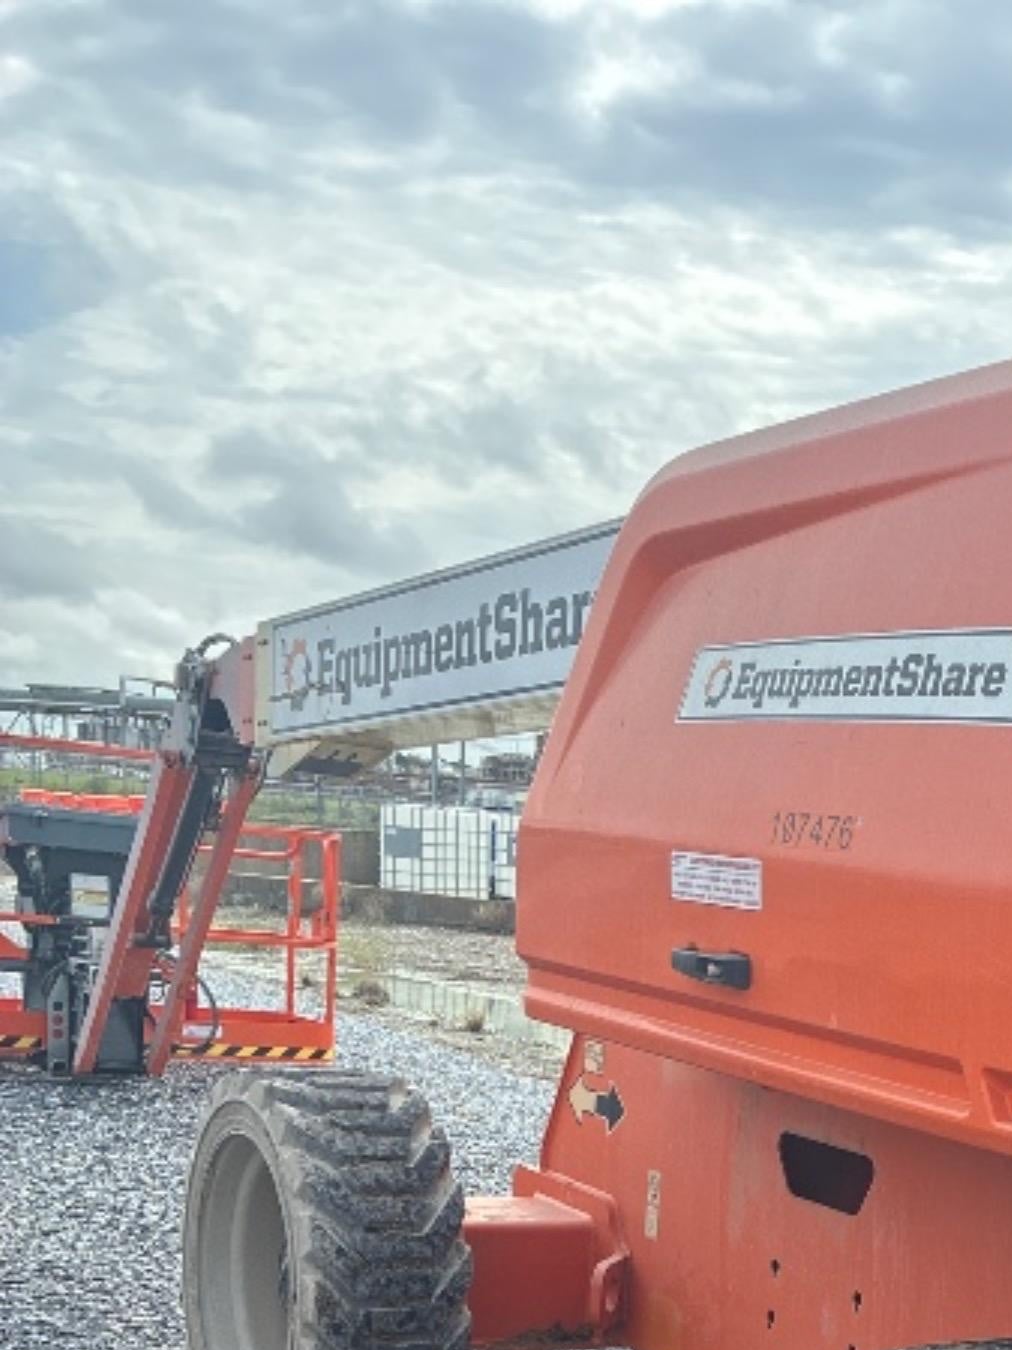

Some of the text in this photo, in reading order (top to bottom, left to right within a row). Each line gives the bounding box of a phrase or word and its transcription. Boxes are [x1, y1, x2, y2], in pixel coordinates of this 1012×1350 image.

[317, 587, 598, 705] EquipmentShar
[731, 653, 1007, 708] EquipmentShare
[769, 811, 855, 850] 107476
